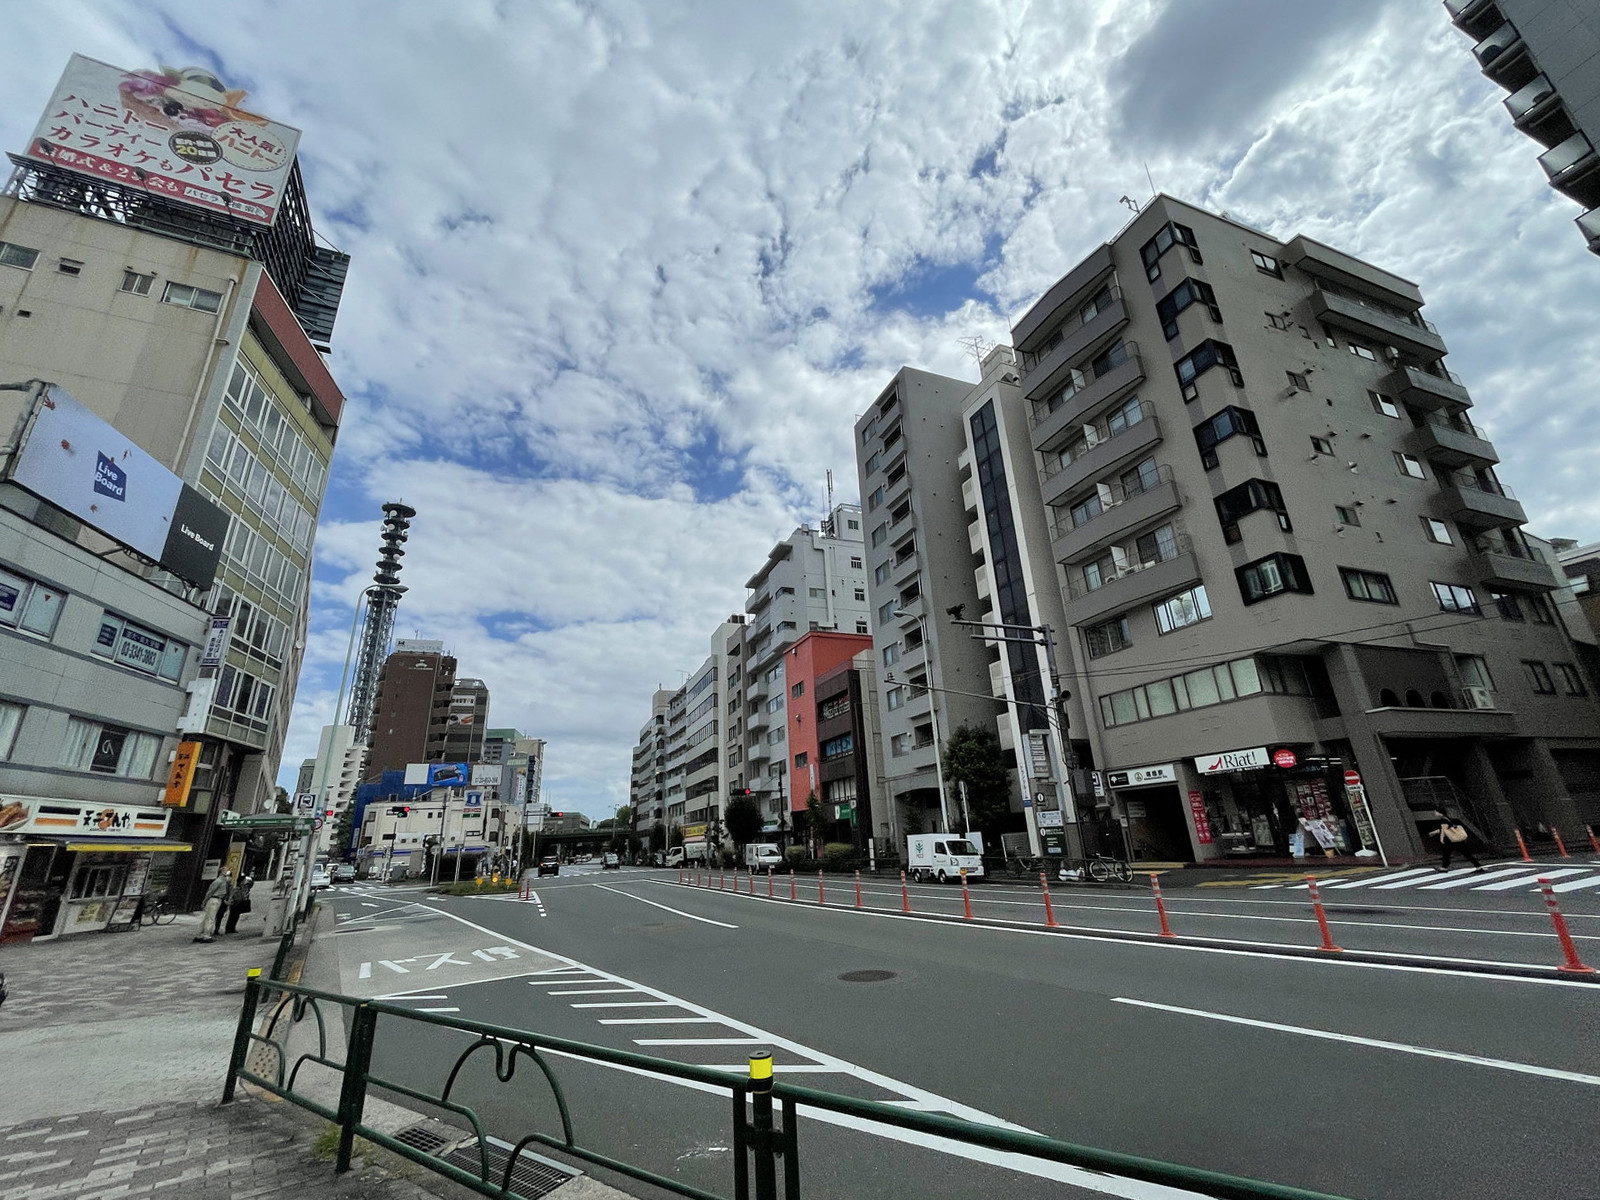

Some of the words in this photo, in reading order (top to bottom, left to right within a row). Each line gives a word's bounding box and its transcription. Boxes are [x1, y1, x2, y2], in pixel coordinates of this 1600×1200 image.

[61, 93, 170, 132] ハニトー
[52, 110, 163, 147] パーティー
[46, 125, 276, 201] カラオケもパセラ
[217, 134, 278, 164] ハニトー
[94, 471, 124, 497] Board
[97, 460, 119, 482] Live
[181, 523, 196, 540] Live
[193, 530, 215, 552] Board
[1223, 751, 1258, 769] Riat!
